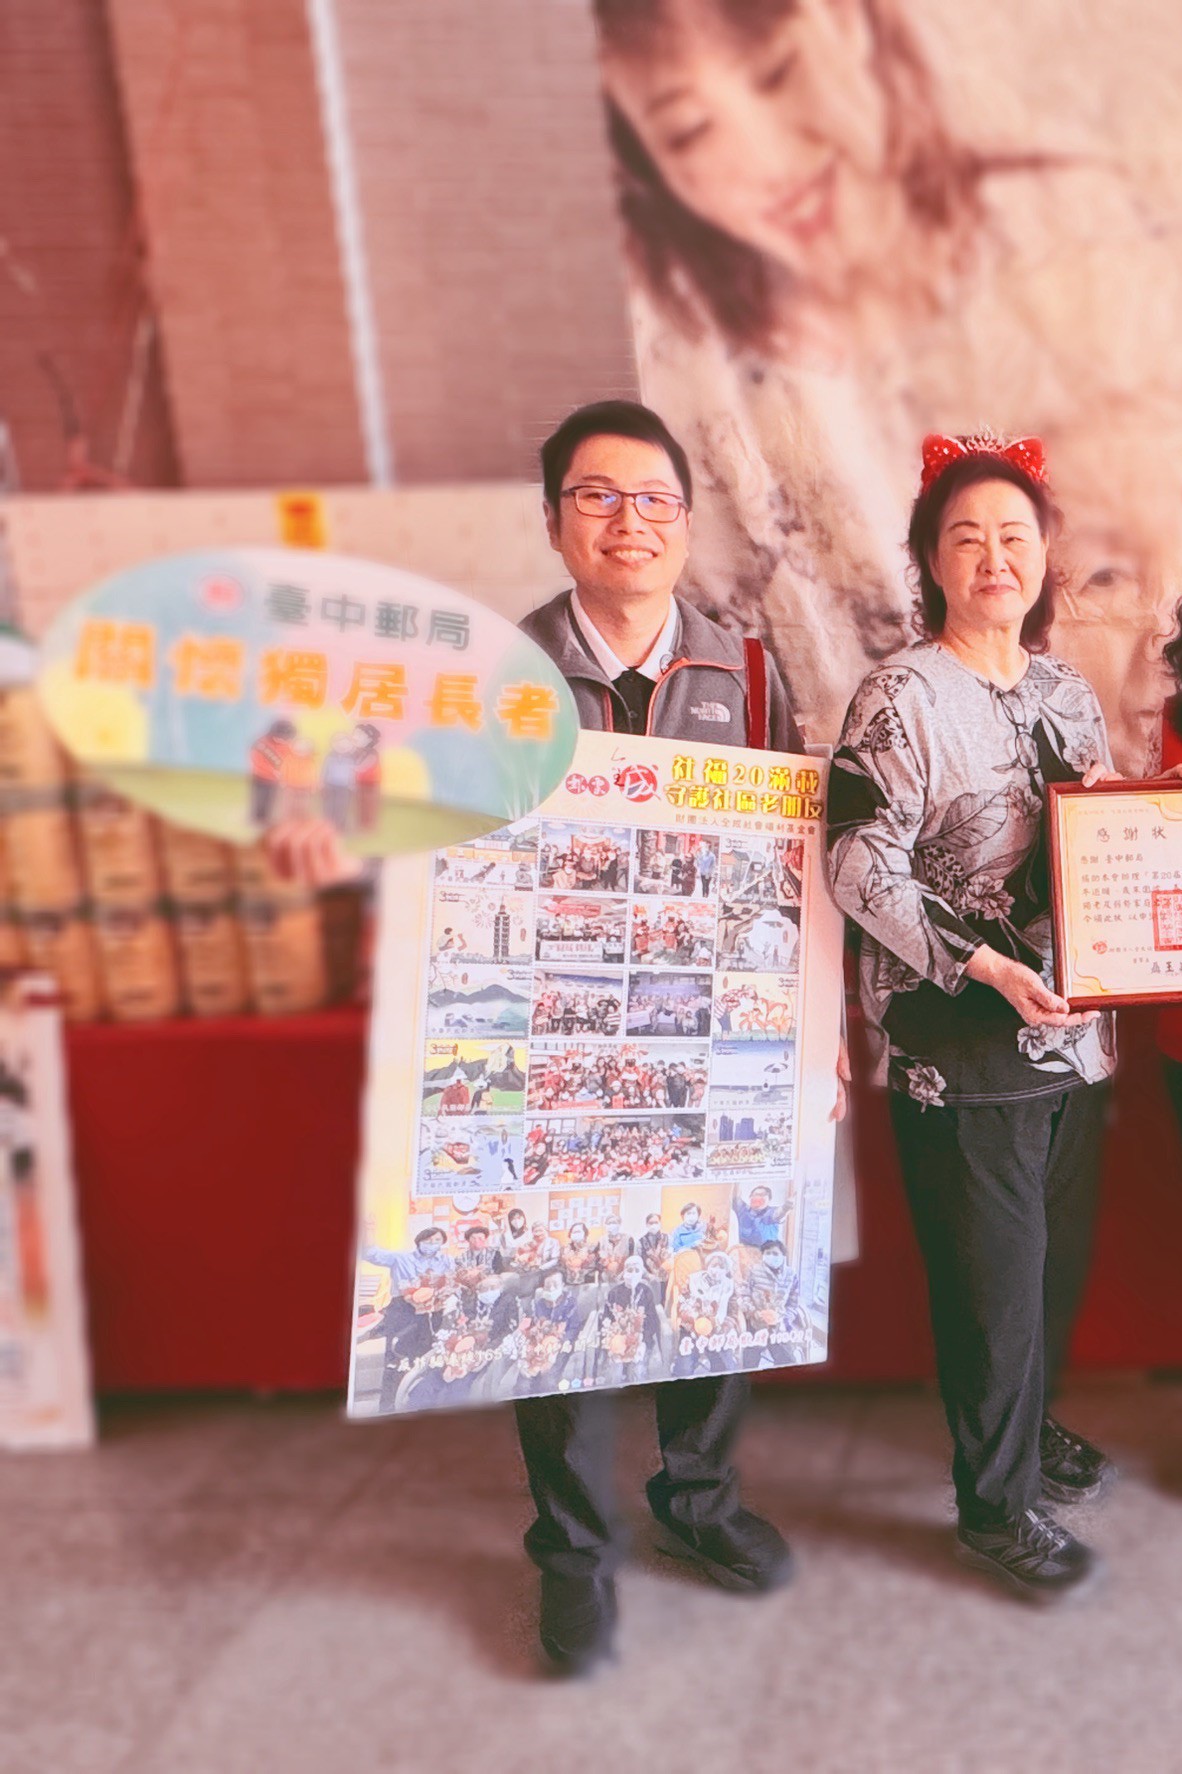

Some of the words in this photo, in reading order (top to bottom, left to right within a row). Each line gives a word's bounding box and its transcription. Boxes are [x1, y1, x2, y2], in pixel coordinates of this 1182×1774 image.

[263, 582, 472, 651] 臺中郵局
[75, 617, 558, 742] 關懷獨居長者
[663, 783, 824, 820] 守護社區老朋友
[672, 754, 820, 796] 社福20滿載
